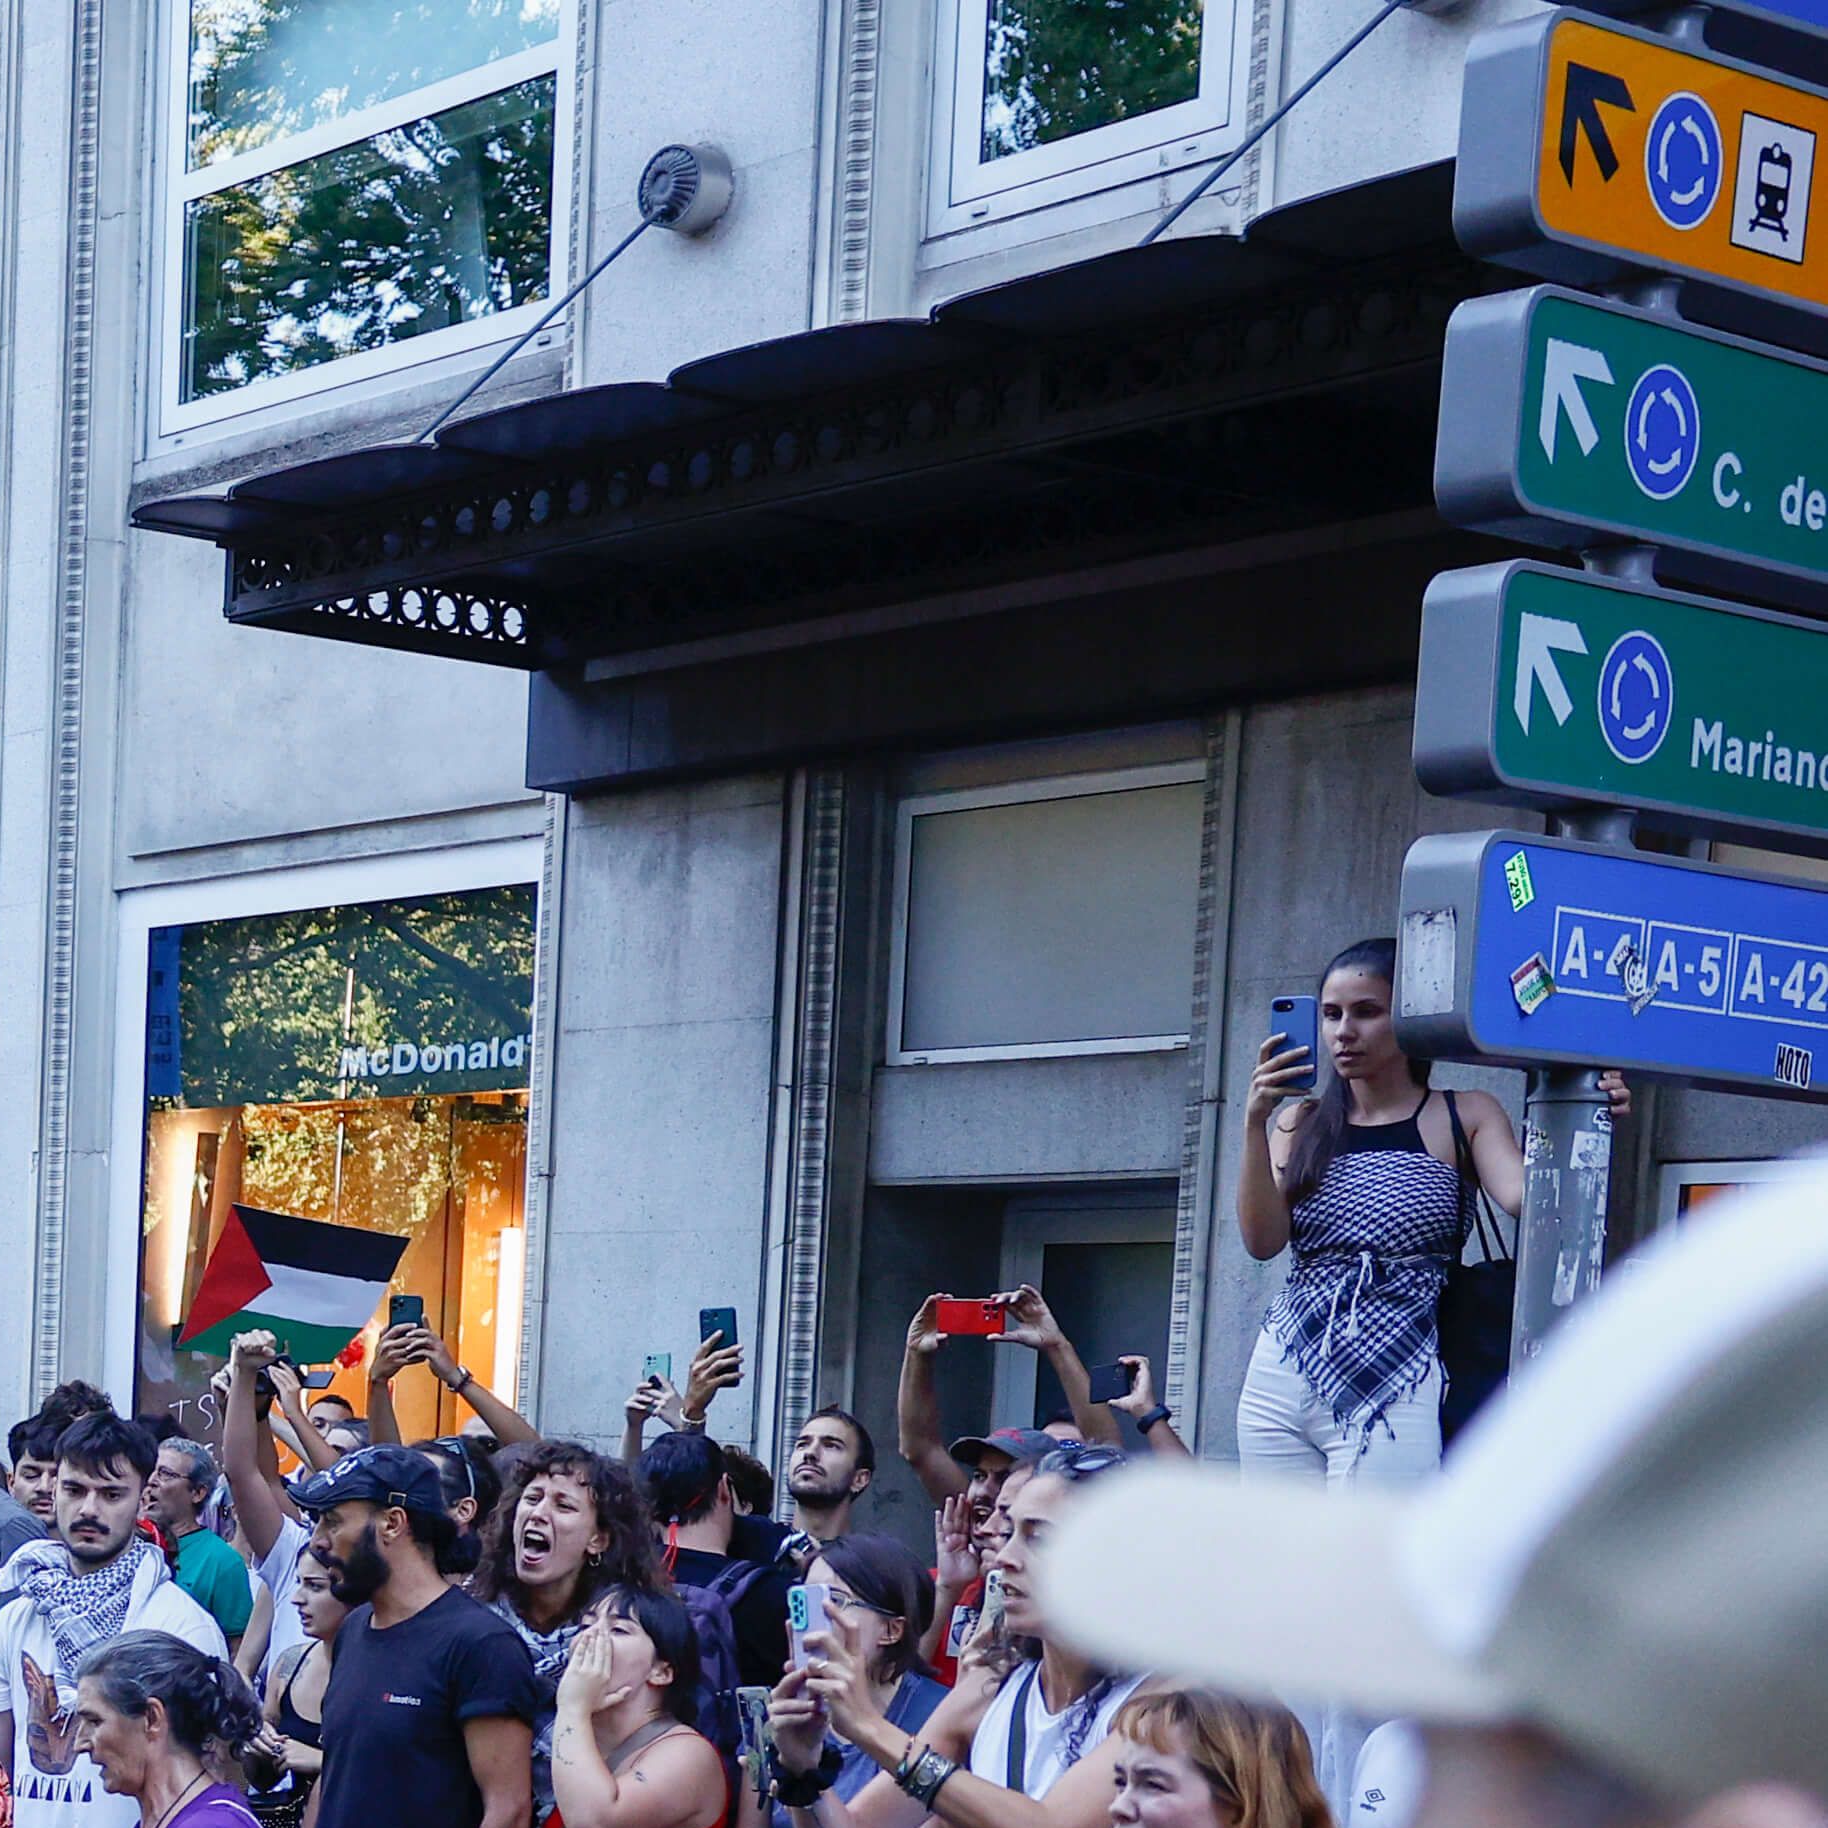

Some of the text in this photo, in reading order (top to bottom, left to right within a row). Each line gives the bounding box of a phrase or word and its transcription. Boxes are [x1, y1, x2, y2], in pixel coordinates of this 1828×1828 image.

[1712, 451, 1827, 530] C. de
[1655, 940, 1723, 997] A-5
[1739, 953, 1828, 1012] A-42
[1777, 1044, 1811, 1087] HOTO
